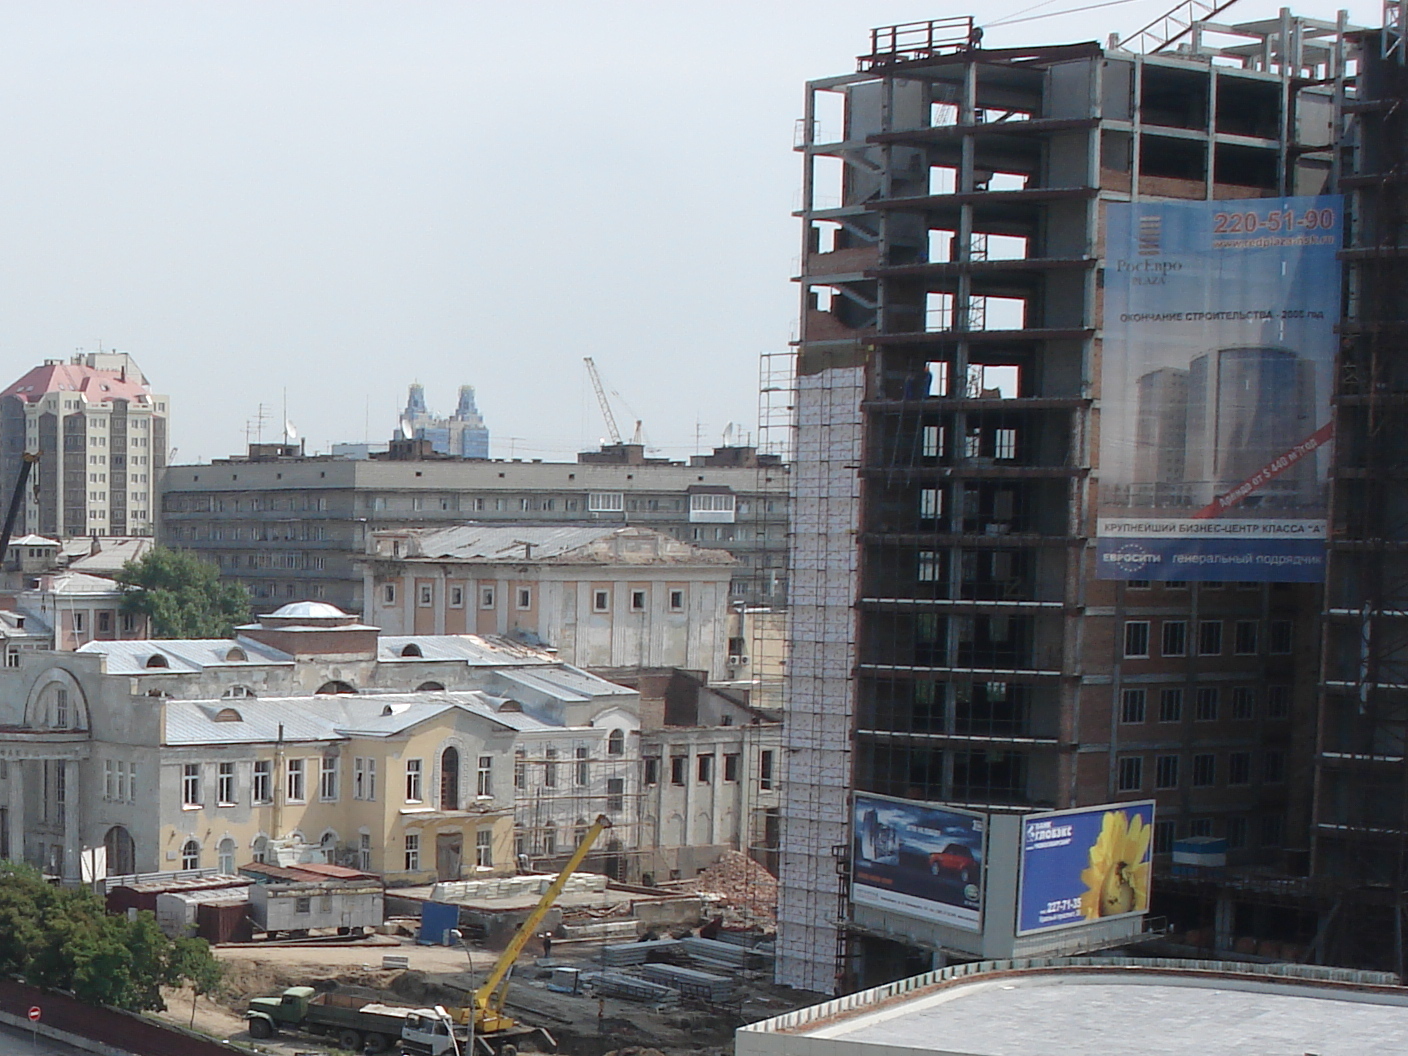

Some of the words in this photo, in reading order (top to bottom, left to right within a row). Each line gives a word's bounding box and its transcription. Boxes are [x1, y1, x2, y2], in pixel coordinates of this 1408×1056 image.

[1213, 209, 1334, 234] 220-51-90
[1103, 523, 1176, 533] КРУПНЕЙШИЙ
[1179, 524, 1260, 534] БИЗНЕС-ЦЕНТР
[1262, 524, 1305, 533] КЛАССА
[1102, 552, 1162, 563] ЕВРОСИТИ
[1172, 553, 1253, 565] генеральный
[1256, 554, 1322, 567] подрядчик
